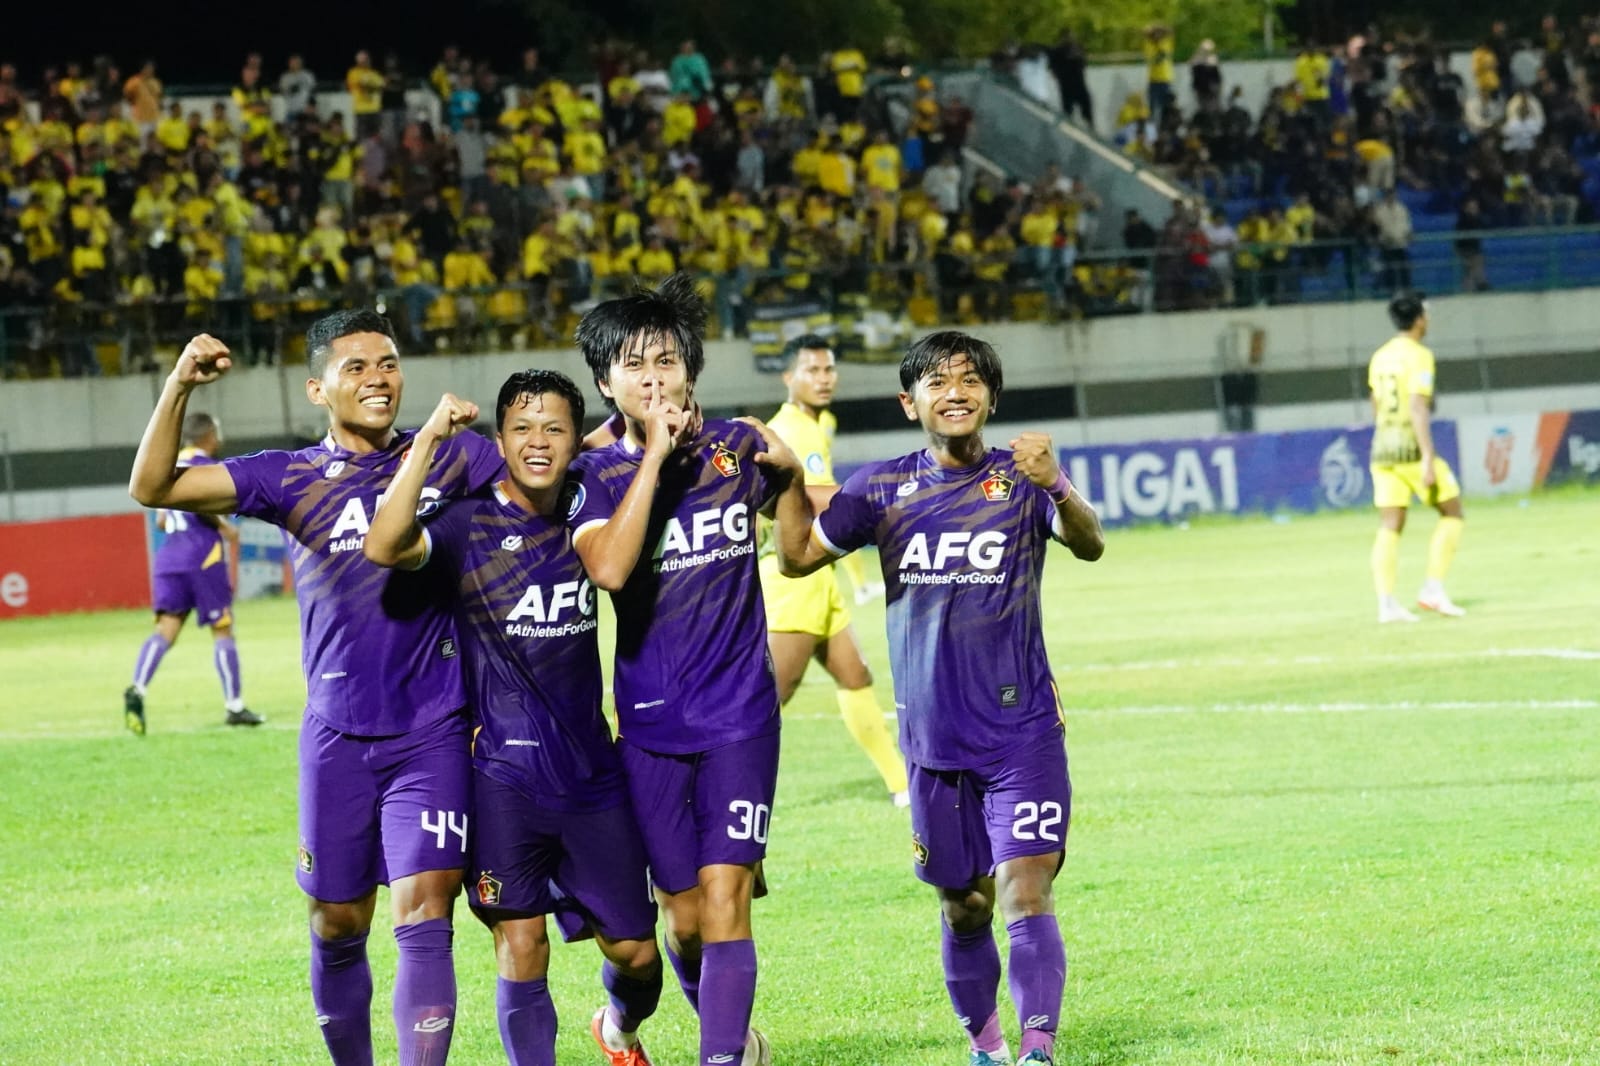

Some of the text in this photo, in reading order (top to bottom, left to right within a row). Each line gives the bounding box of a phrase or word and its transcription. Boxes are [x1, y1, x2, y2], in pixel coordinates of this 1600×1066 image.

[651, 502, 749, 560] AFG
[898, 531, 1008, 570] AFG
[899, 572, 1006, 584] #AthletesForGood
[505, 578, 595, 622] AFG
[421, 810, 468, 852] 44
[727, 800, 769, 844] 30
[1012, 801, 1062, 841] 22
